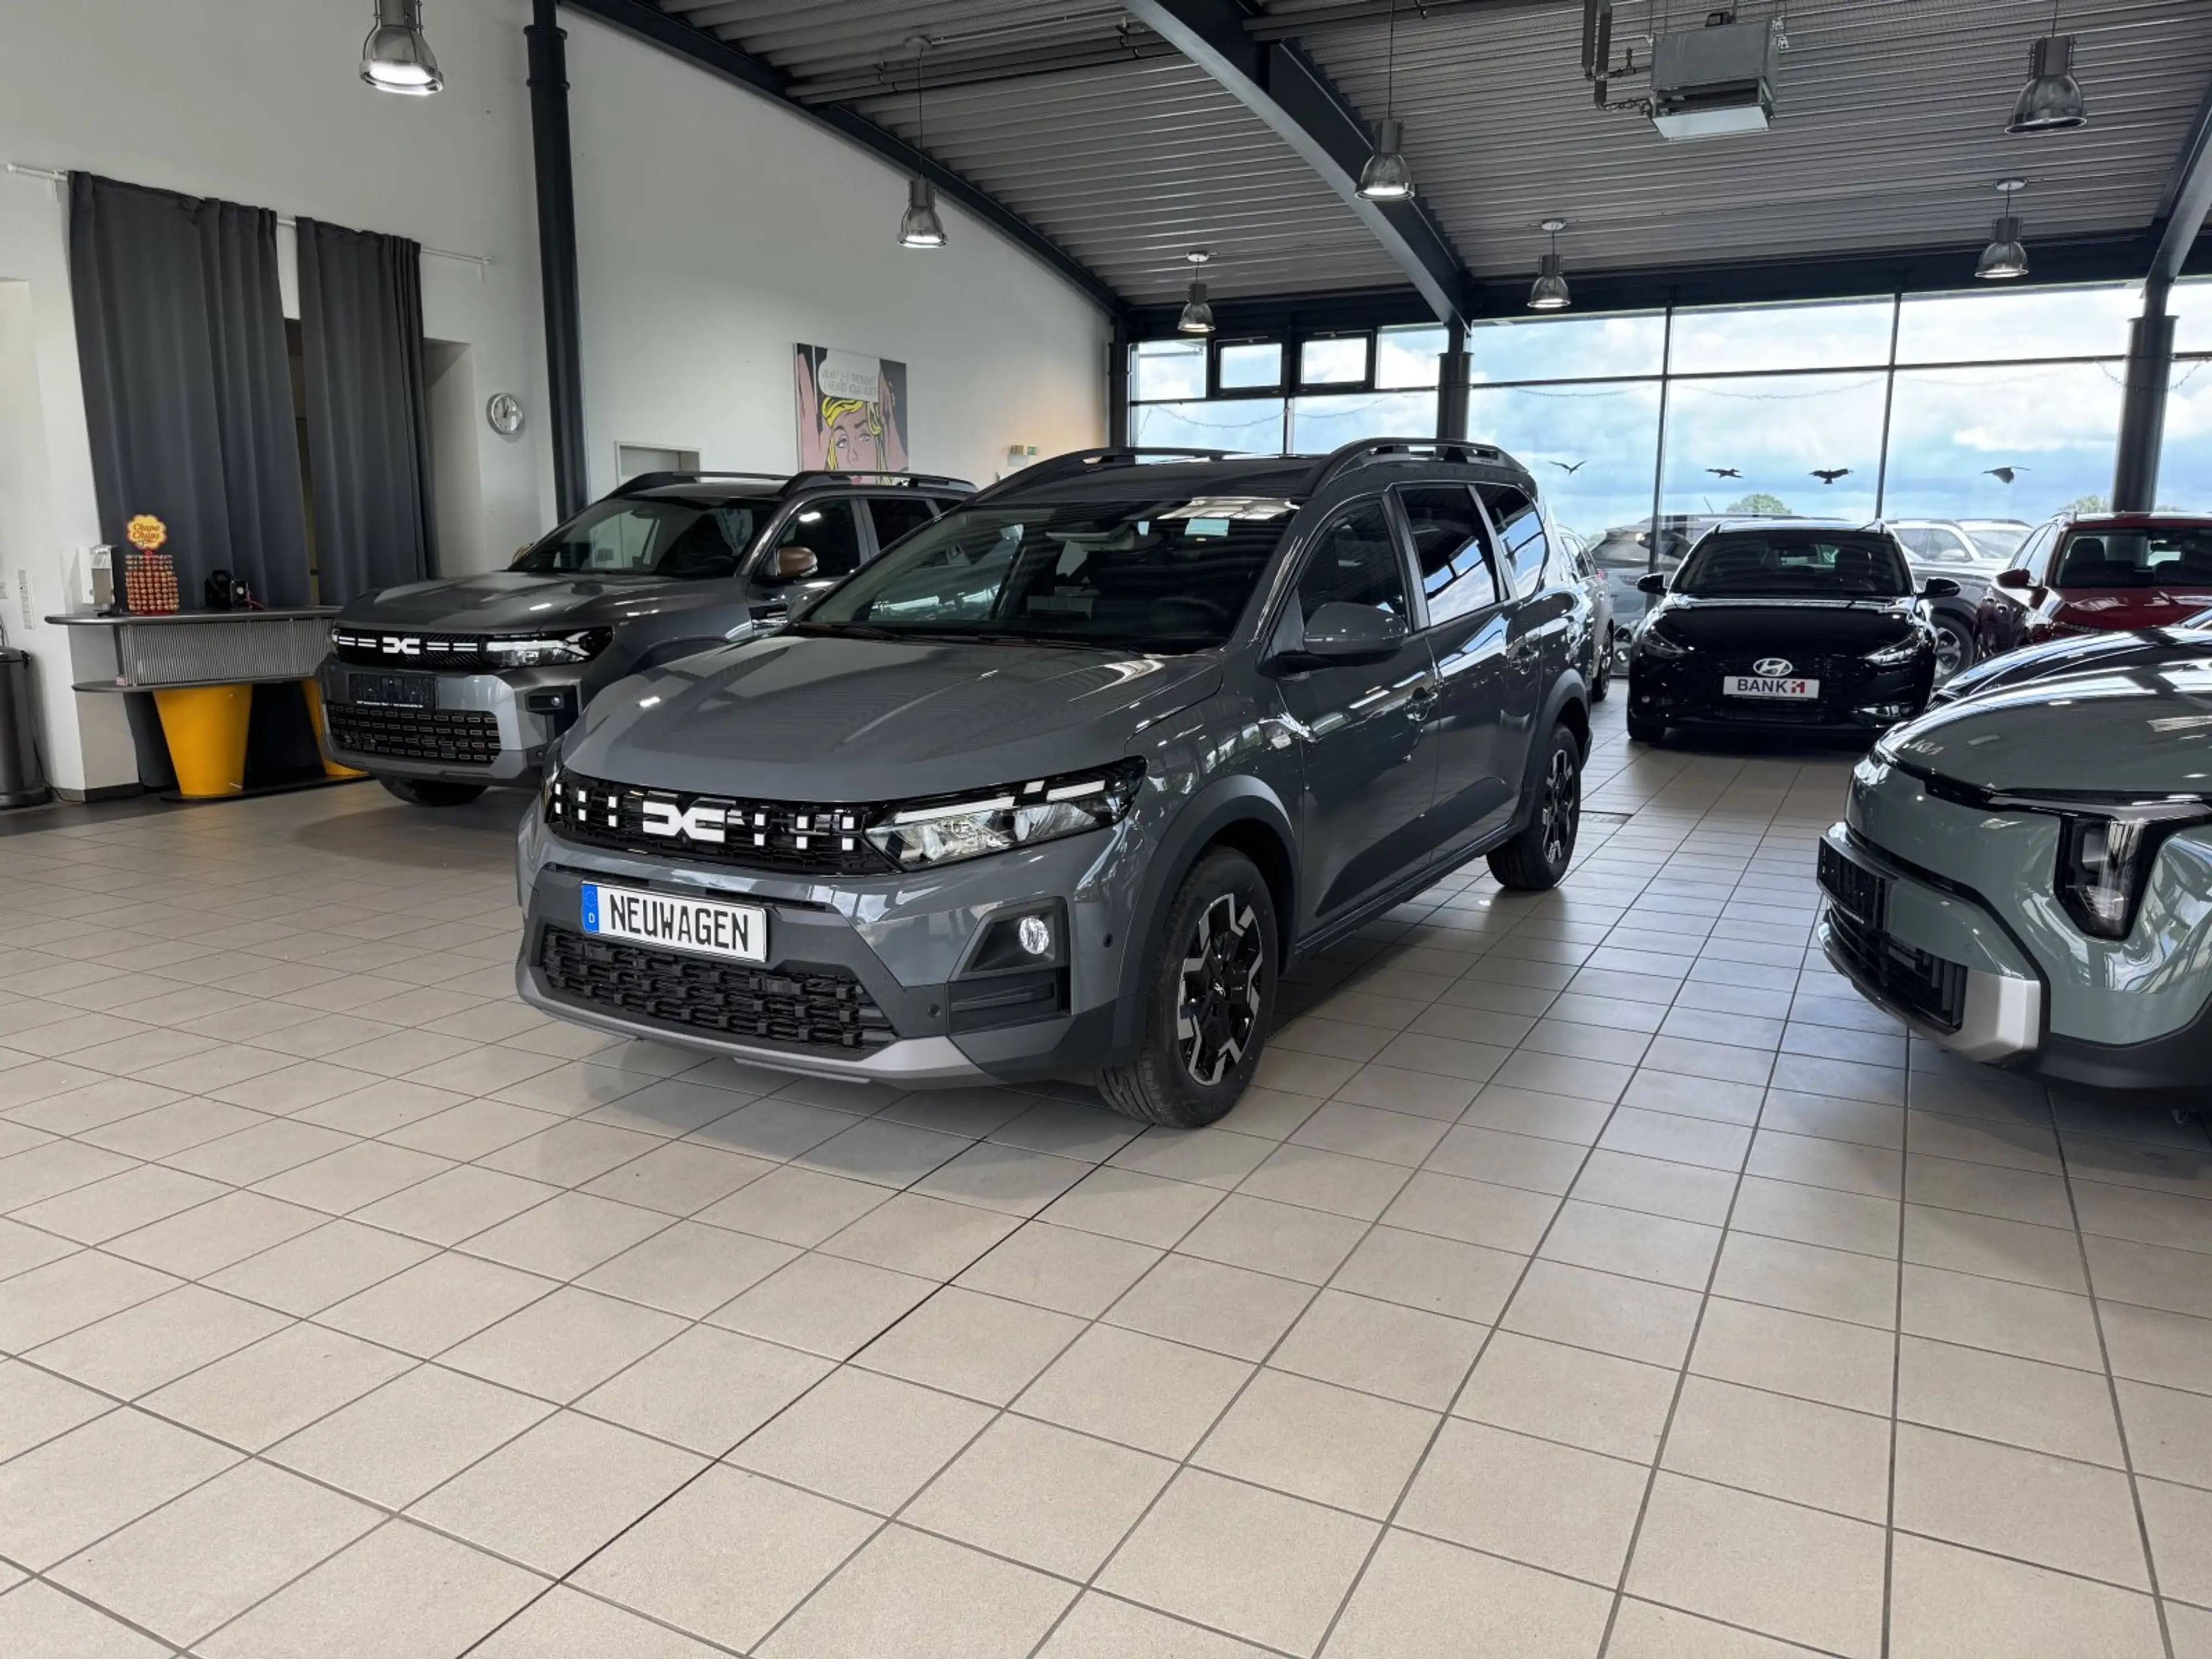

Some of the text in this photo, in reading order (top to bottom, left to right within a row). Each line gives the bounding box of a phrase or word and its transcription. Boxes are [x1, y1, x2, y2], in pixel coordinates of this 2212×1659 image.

[1737, 679, 1787, 694] BANK
[588, 894, 749, 952] D NEUWAGEN
